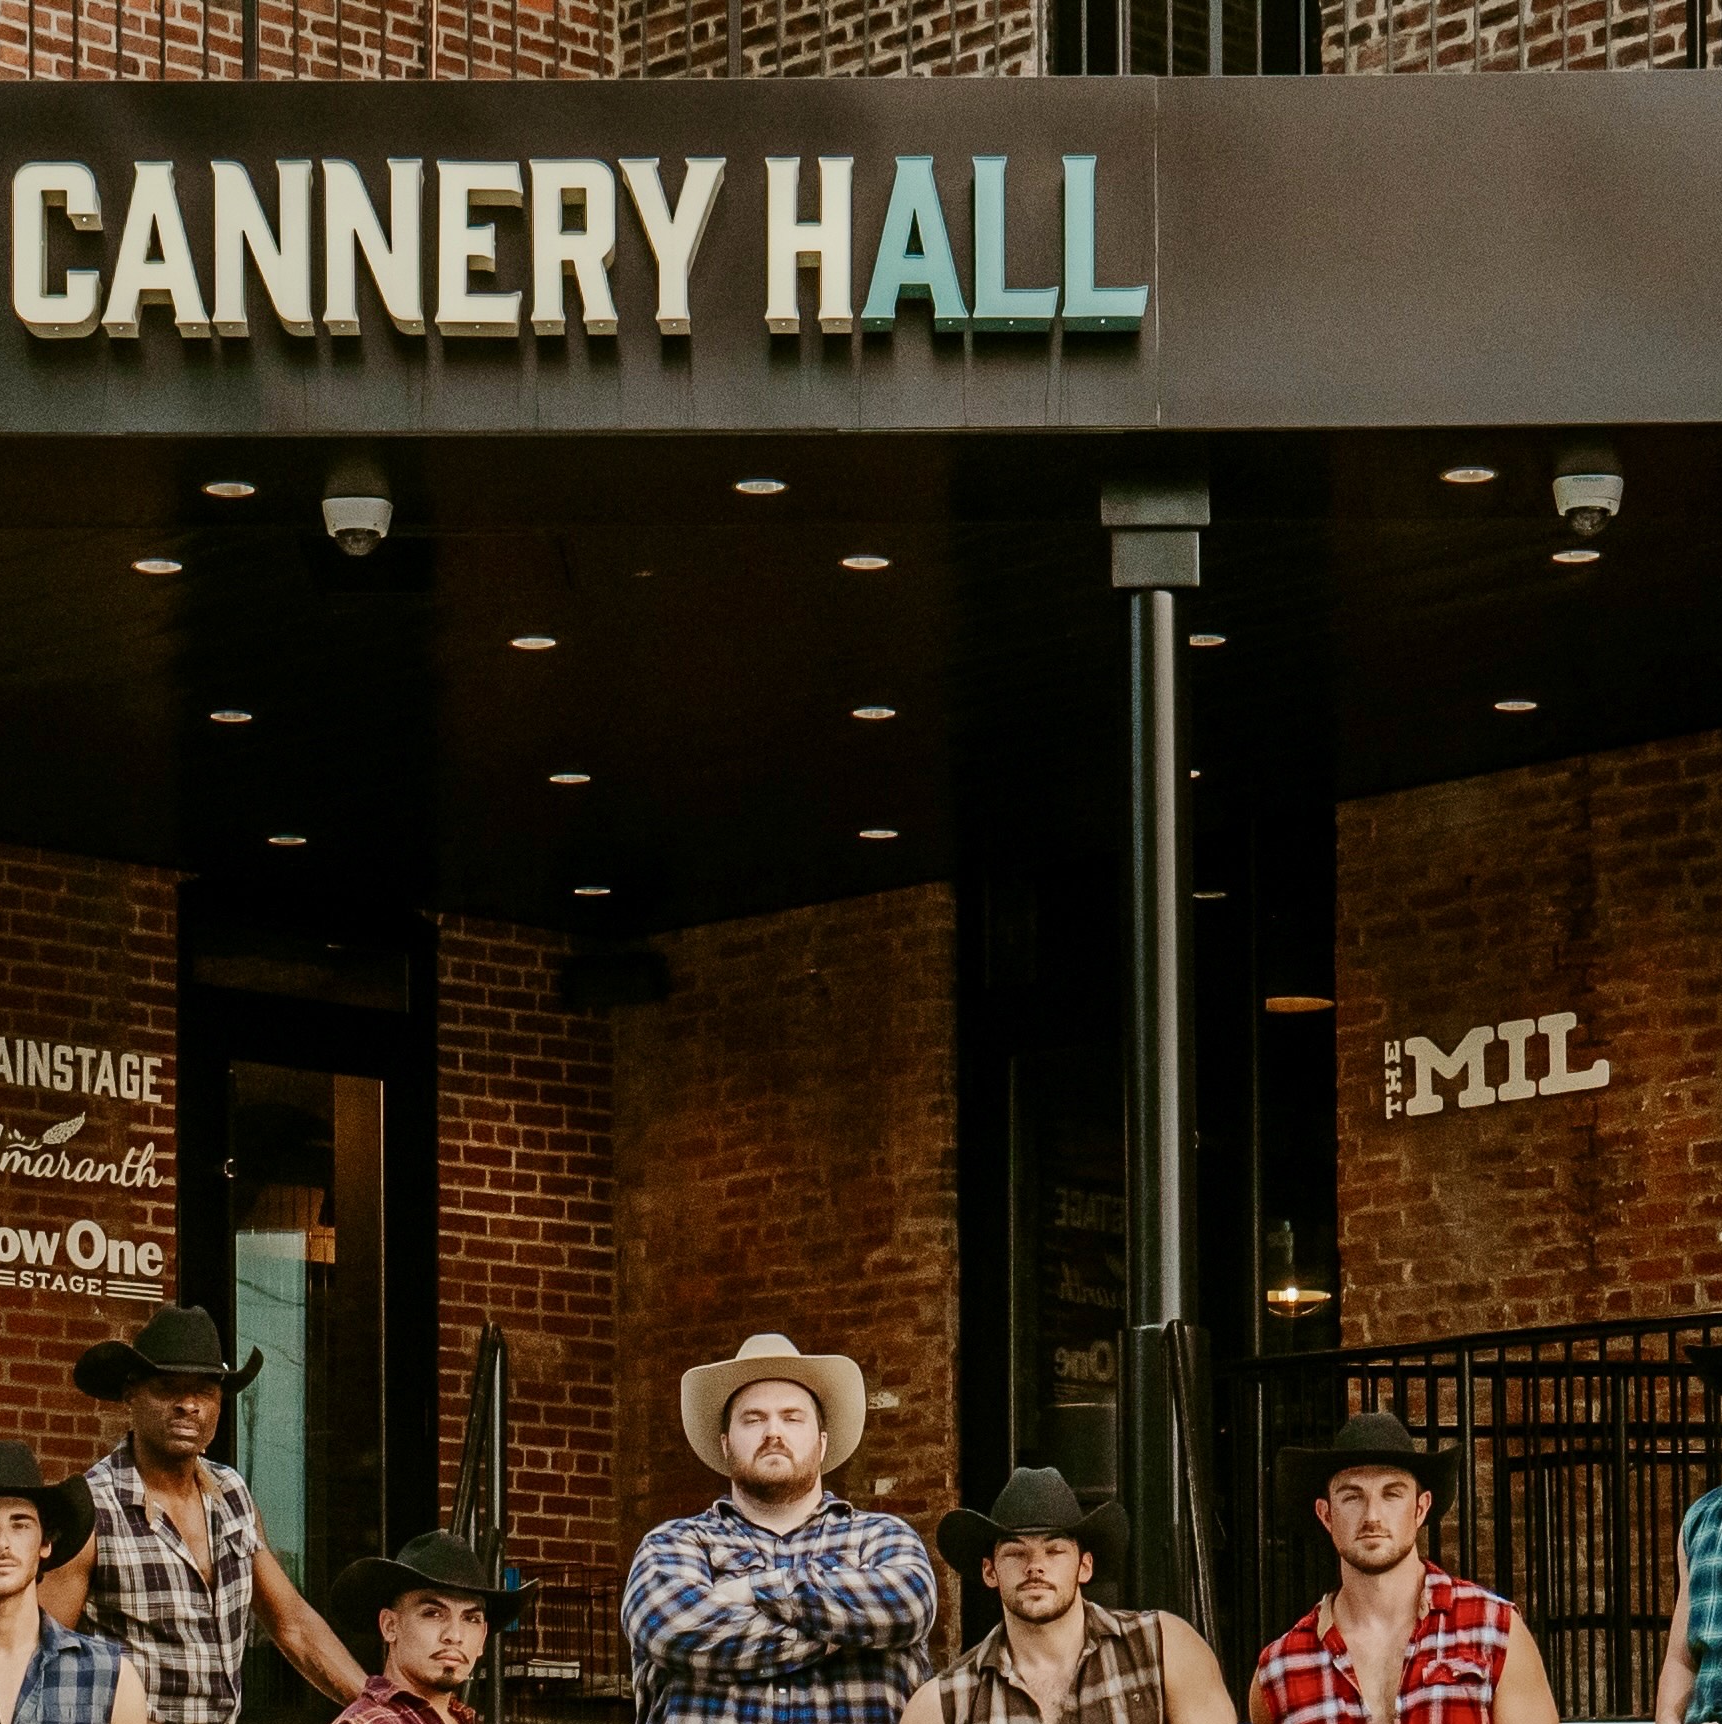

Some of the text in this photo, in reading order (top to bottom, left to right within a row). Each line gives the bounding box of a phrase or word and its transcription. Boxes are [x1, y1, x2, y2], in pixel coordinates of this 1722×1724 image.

[12, 154, 1149, 339] CANNERY HALL
[1384, 1040, 1402, 1119] THE
[1404, 1011, 1610, 1116] MIL
[19, 1271, 103, 1296] STAGE
[65, 1219, 164, 1277] One
